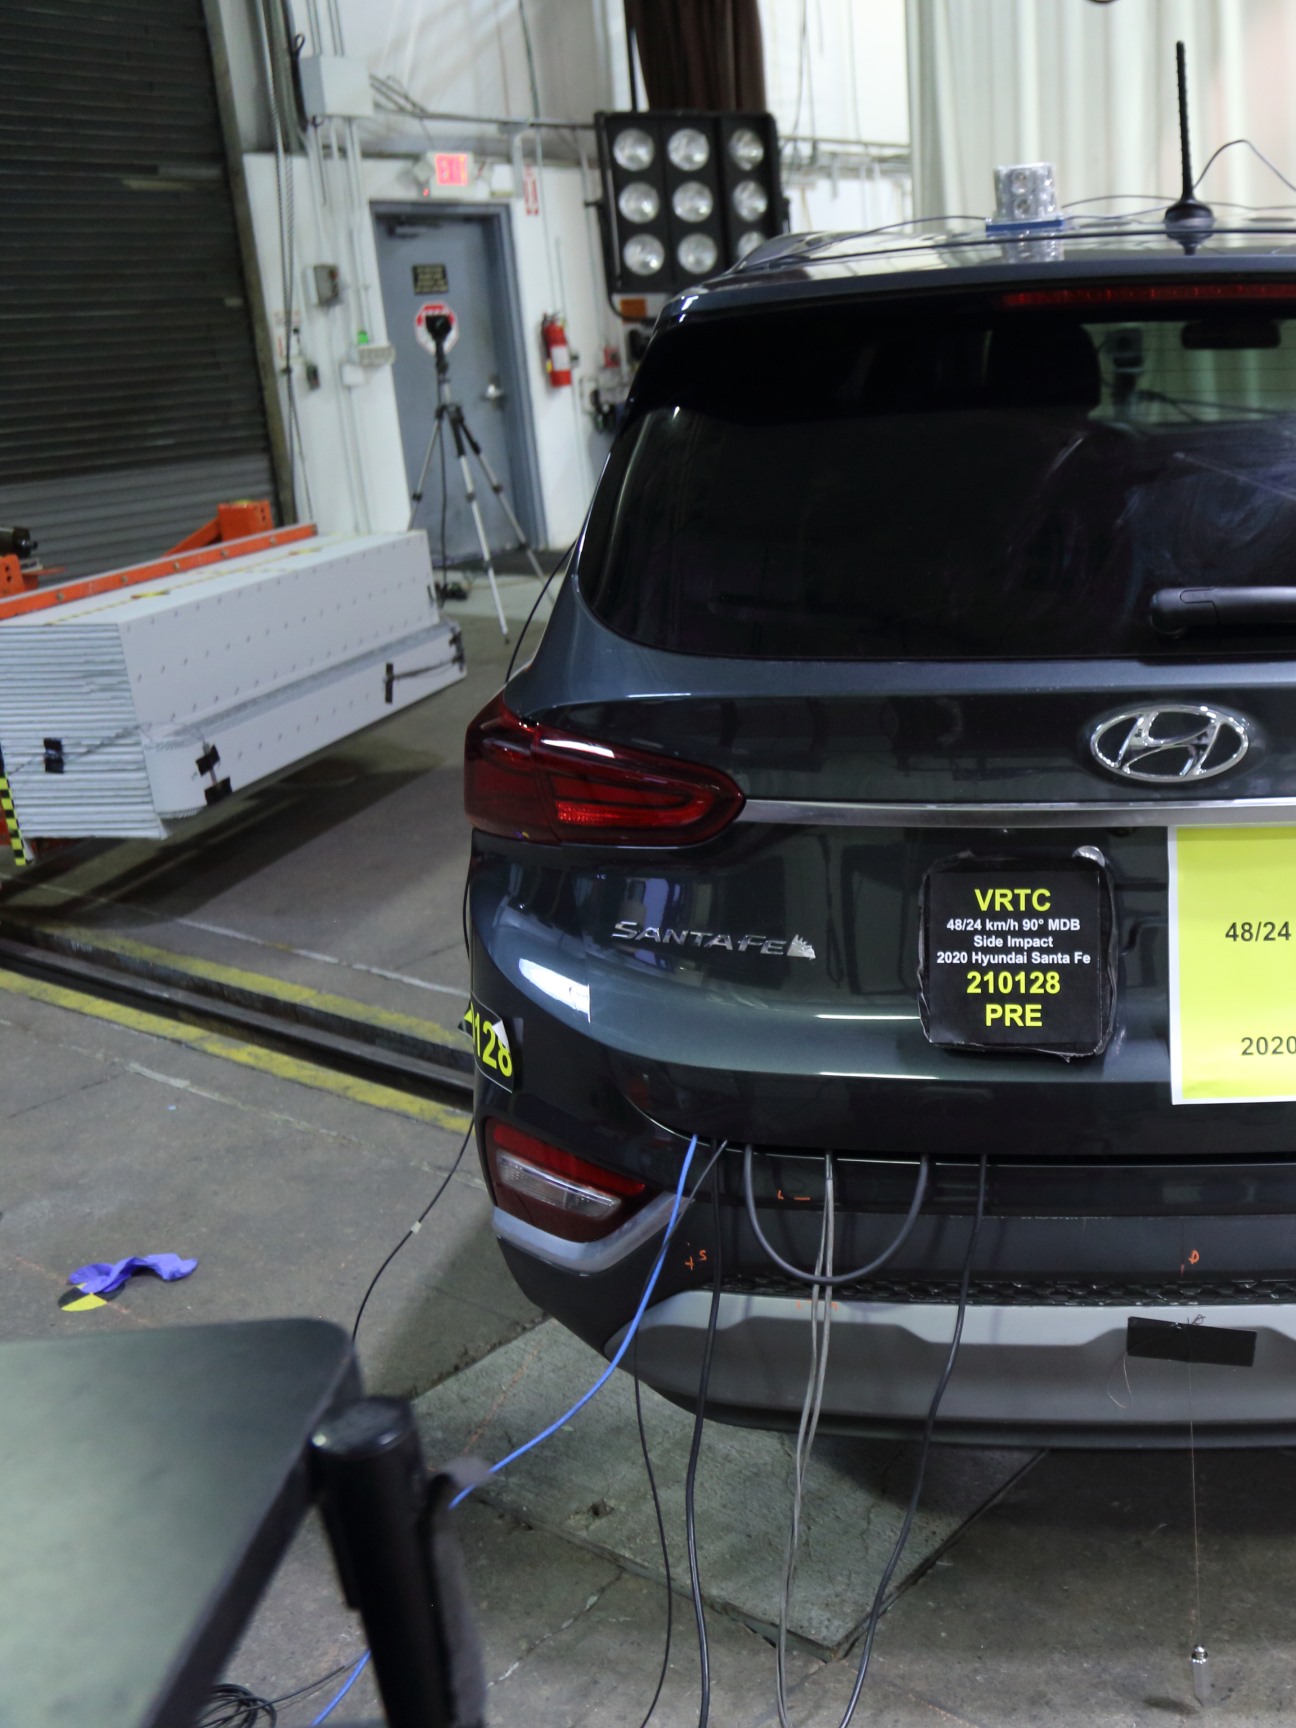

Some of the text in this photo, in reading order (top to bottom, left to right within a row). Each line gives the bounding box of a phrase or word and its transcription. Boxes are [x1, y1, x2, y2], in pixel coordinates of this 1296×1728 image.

[974, 888, 1051, 912] VRTC
[946, 917, 1081, 932] 48/24 km/h 90° MDB
[1225, 921, 1292, 943] 48/24
[611, 921, 787, 955] SANTA FE
[973, 934, 1054, 951] Side Impact
[936, 951, 1091, 967] 2020 Hyundai Santa Fe
[966, 970, 1061, 995] 210128
[985, 1003, 1043, 1027] PRE
